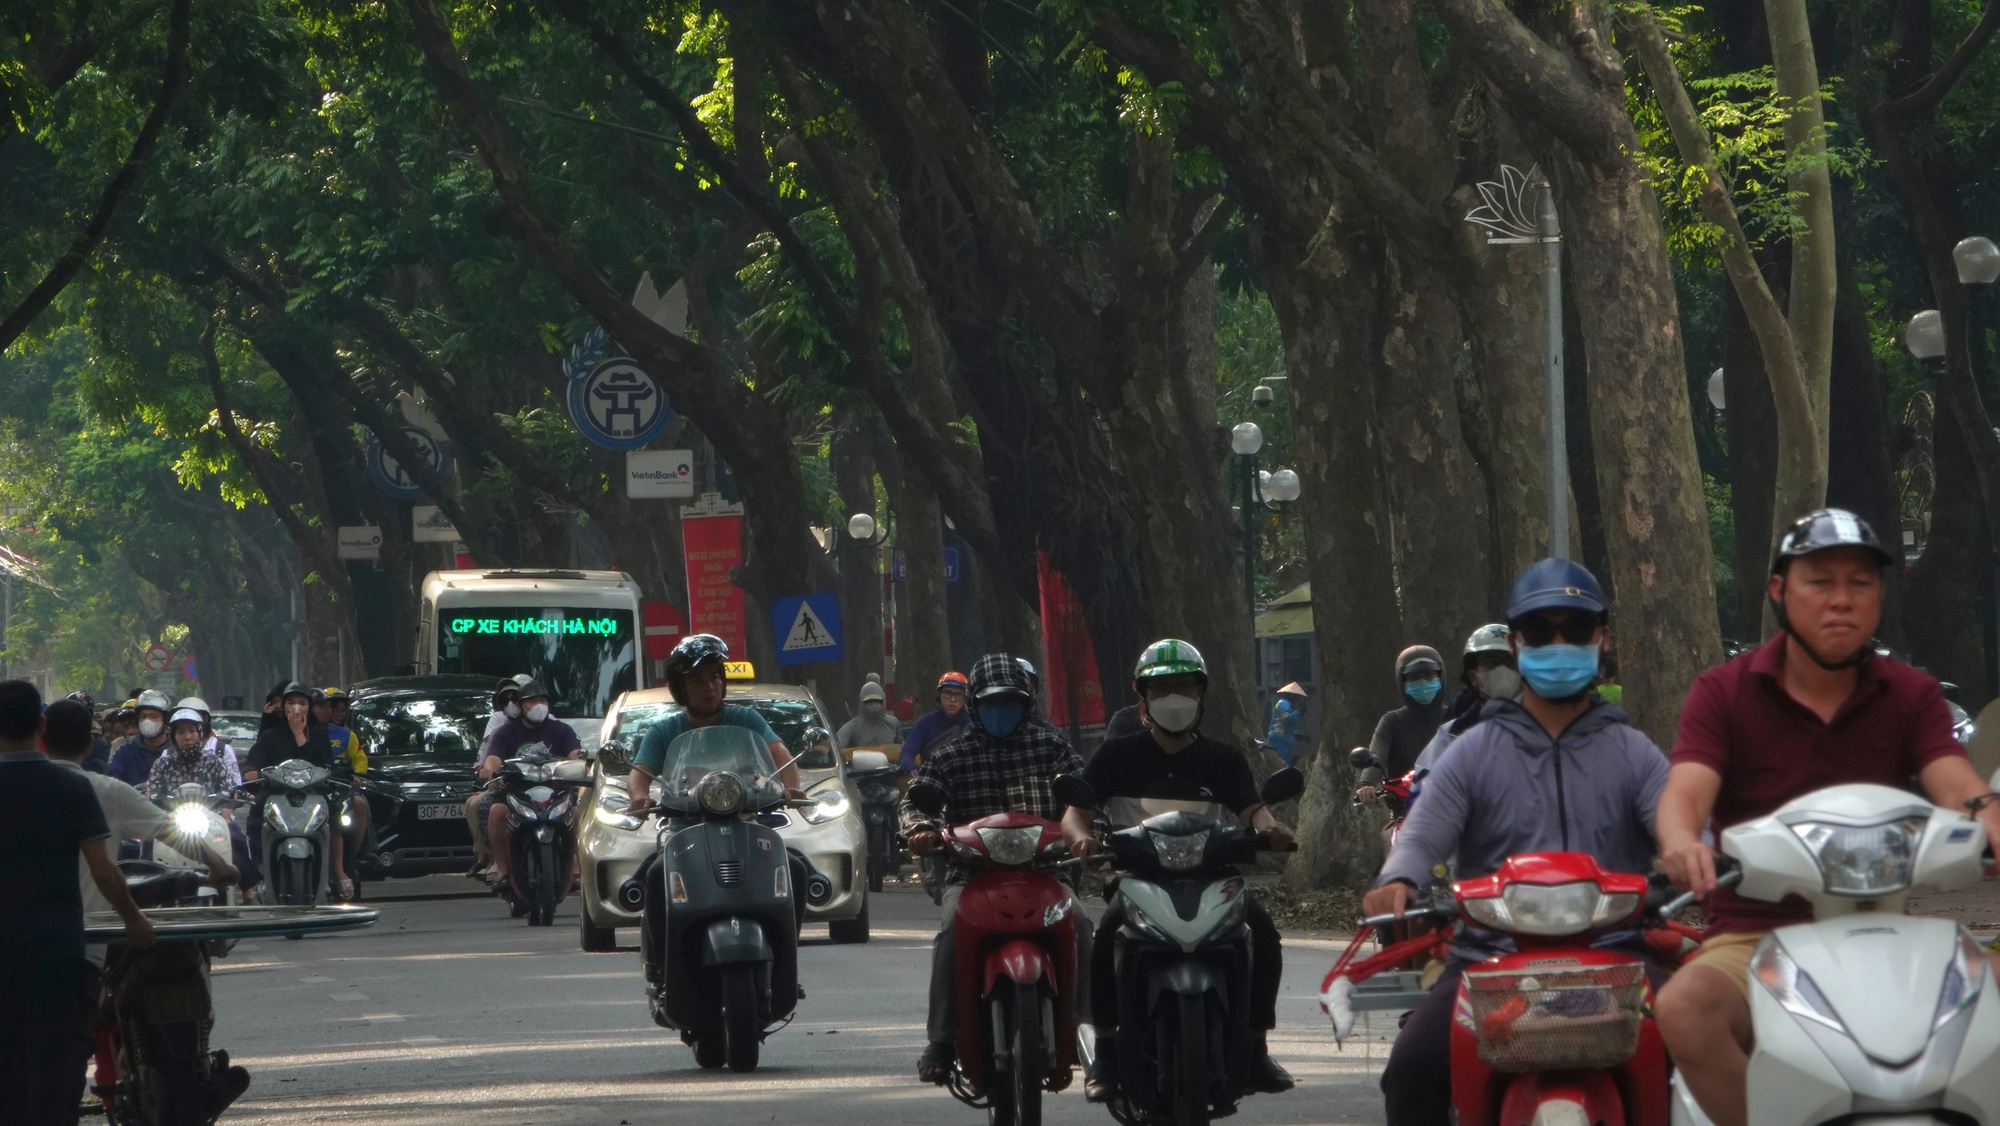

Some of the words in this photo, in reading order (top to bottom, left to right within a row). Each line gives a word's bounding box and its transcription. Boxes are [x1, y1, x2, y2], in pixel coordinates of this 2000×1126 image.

[632, 470, 678, 479] VietinBank
[452, 619, 475, 633] CP
[477, 619, 499, 633] XE
[503, 617, 559, 634] KHÁCH
[563, 617, 585, 634] HÀ
[588, 618, 617, 637] NỘI
[723, 664, 747, 673] AXI
[419, 804, 467, 818] 30F-764.
